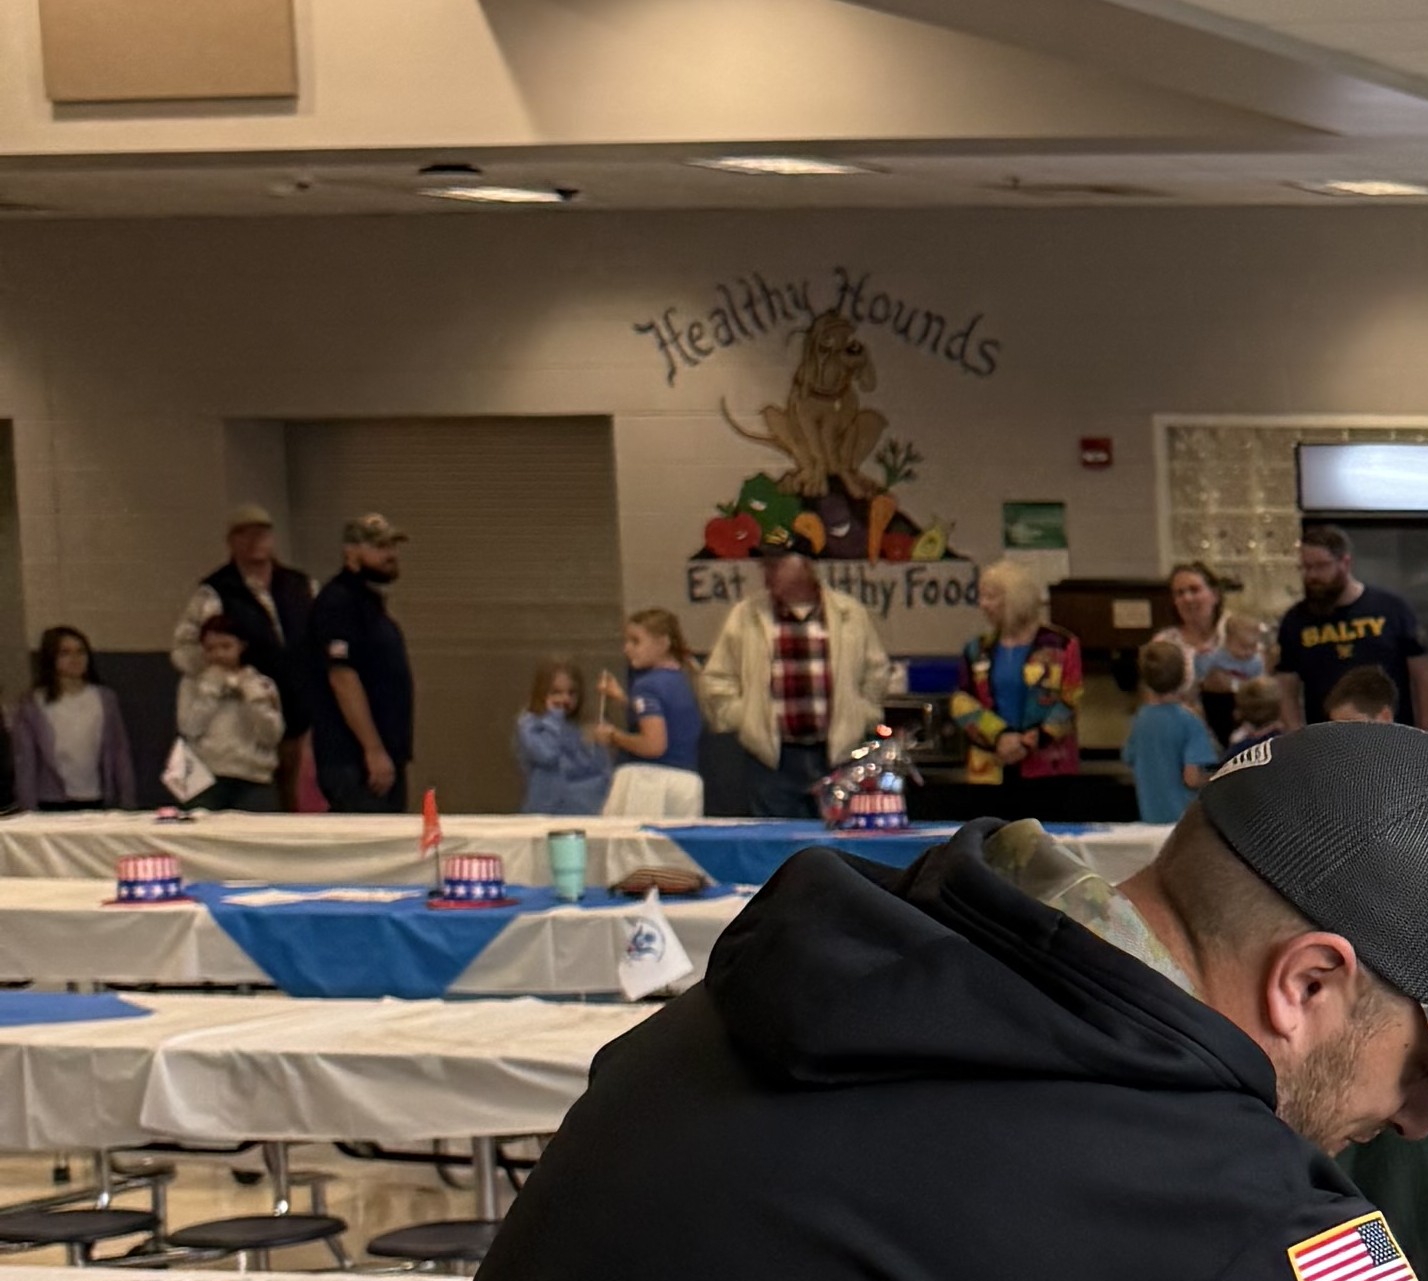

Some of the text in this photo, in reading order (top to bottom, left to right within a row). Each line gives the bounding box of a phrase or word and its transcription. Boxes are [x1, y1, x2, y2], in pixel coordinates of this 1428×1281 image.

[635, 265, 1000, 388] Healthy Hounds
[686, 566, 747, 602] Eat
[904, 566, 981, 608] Food
[1302, 616, 1386, 648] SALTY
